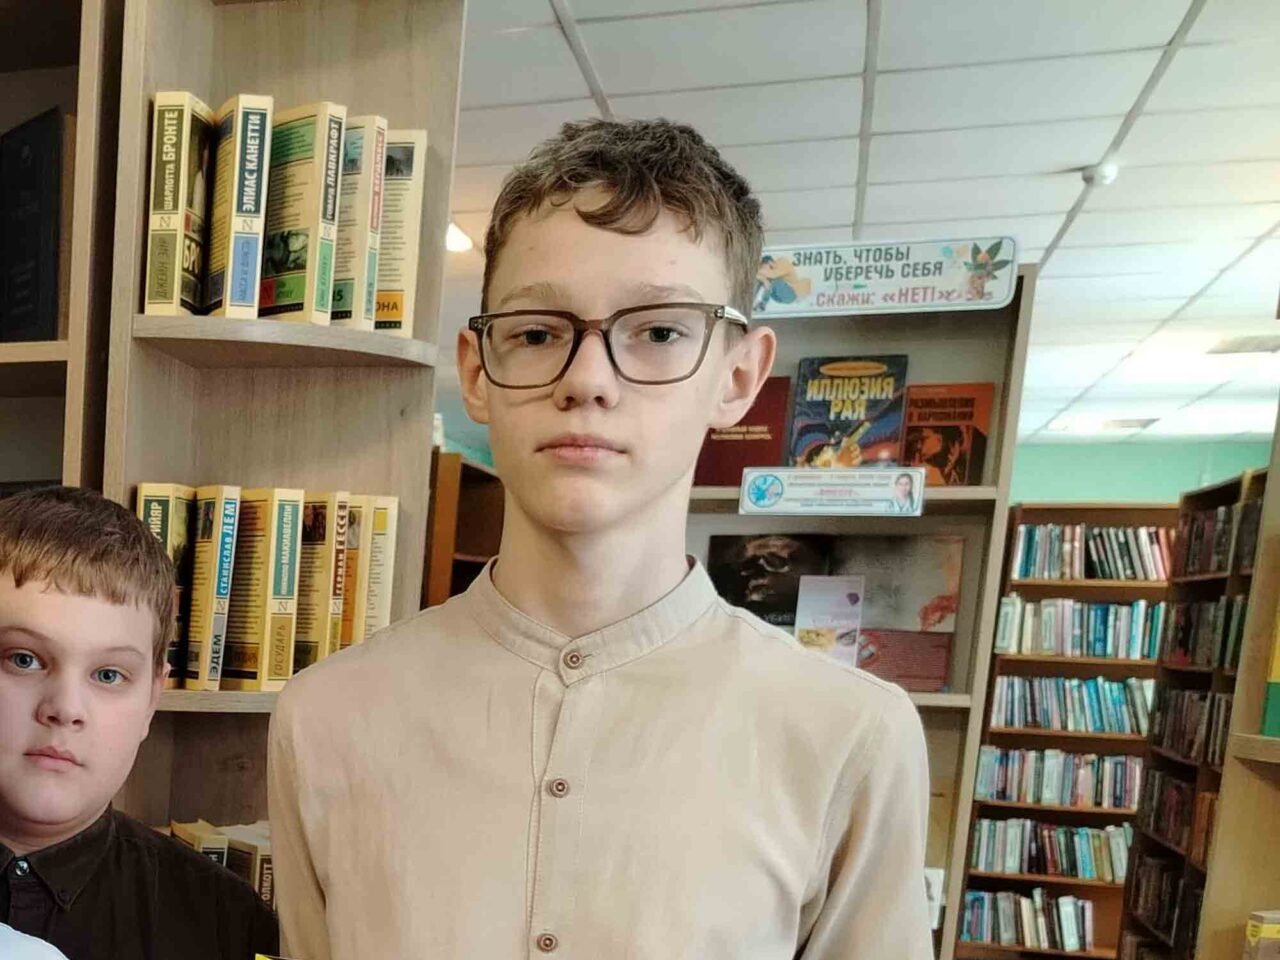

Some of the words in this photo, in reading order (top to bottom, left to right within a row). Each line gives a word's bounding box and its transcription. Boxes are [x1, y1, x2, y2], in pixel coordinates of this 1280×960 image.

[162, 110, 178, 161] БРОНТЕ
[243, 114, 260, 170] КАНЕТТИ
[327, 121, 340, 187] ЛАВКРАФТ
[163, 161, 176, 210] ШАРЛОТТА
[242, 171, 257, 212] ЭЛИАС
[823, 264, 895, 282] УБЕРЕЧЬ
[900, 261, 943, 278] СЕБЯ
[853, 246, 911, 264] ЧТОБЫ
[805, 377, 895, 401] ИЛЛЮЗИЯ
[829, 399, 867, 420] РАЯ
[223, 504, 236, 536] ЛЕМ
[282, 504, 293, 564] МАКИАВЕЛЛИ
[336, 507, 347, 550] ГЕССЕ
[219, 536, 233, 594] СТАНИСЛАВ
[209, 633, 222, 675] ЭДЕМ
[274, 623, 287, 677] ГОСУДАРЬ
